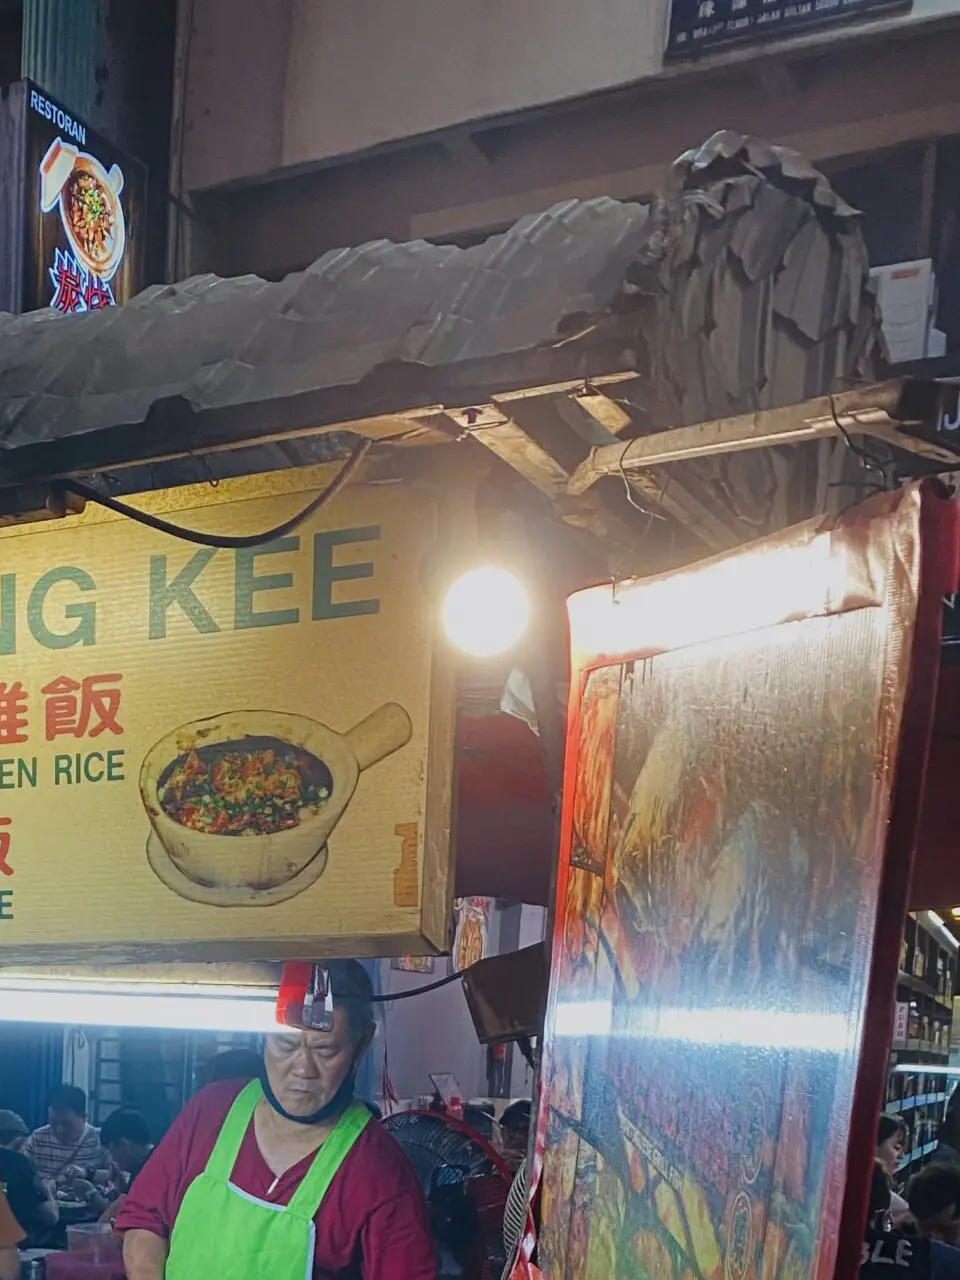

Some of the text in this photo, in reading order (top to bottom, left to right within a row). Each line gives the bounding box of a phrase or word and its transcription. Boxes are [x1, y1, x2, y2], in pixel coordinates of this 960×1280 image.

[30, 90, 87, 145] RESTORAN
[148, 525, 383, 641] KEE
[54, 749, 126, 786] RICE
